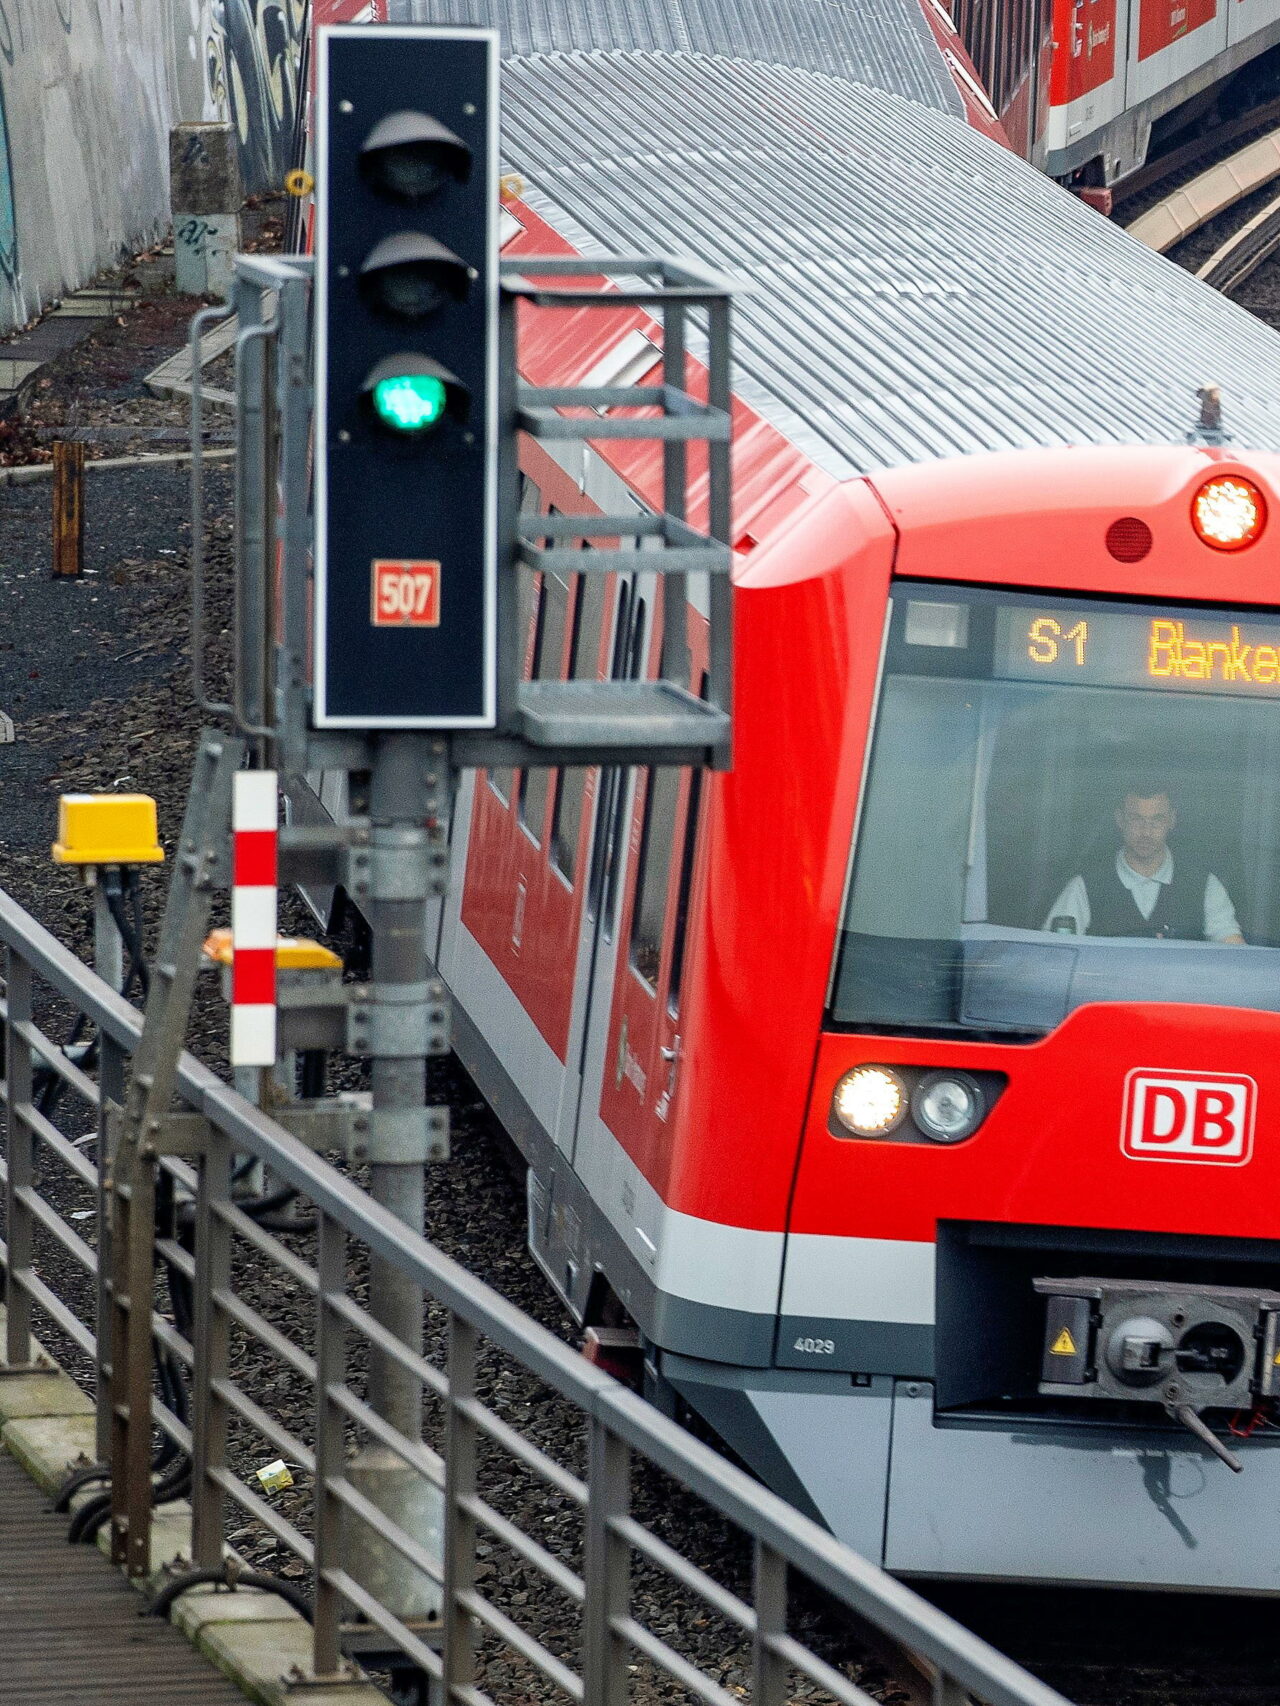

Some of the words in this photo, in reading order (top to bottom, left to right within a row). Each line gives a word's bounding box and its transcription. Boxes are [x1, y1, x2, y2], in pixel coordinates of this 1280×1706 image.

[381, 573, 433, 615] 507
[1028, 618, 1089, 665] S1
[1141, 1085, 1235, 1147] DB
[793, 1337, 835, 1355] 4029
